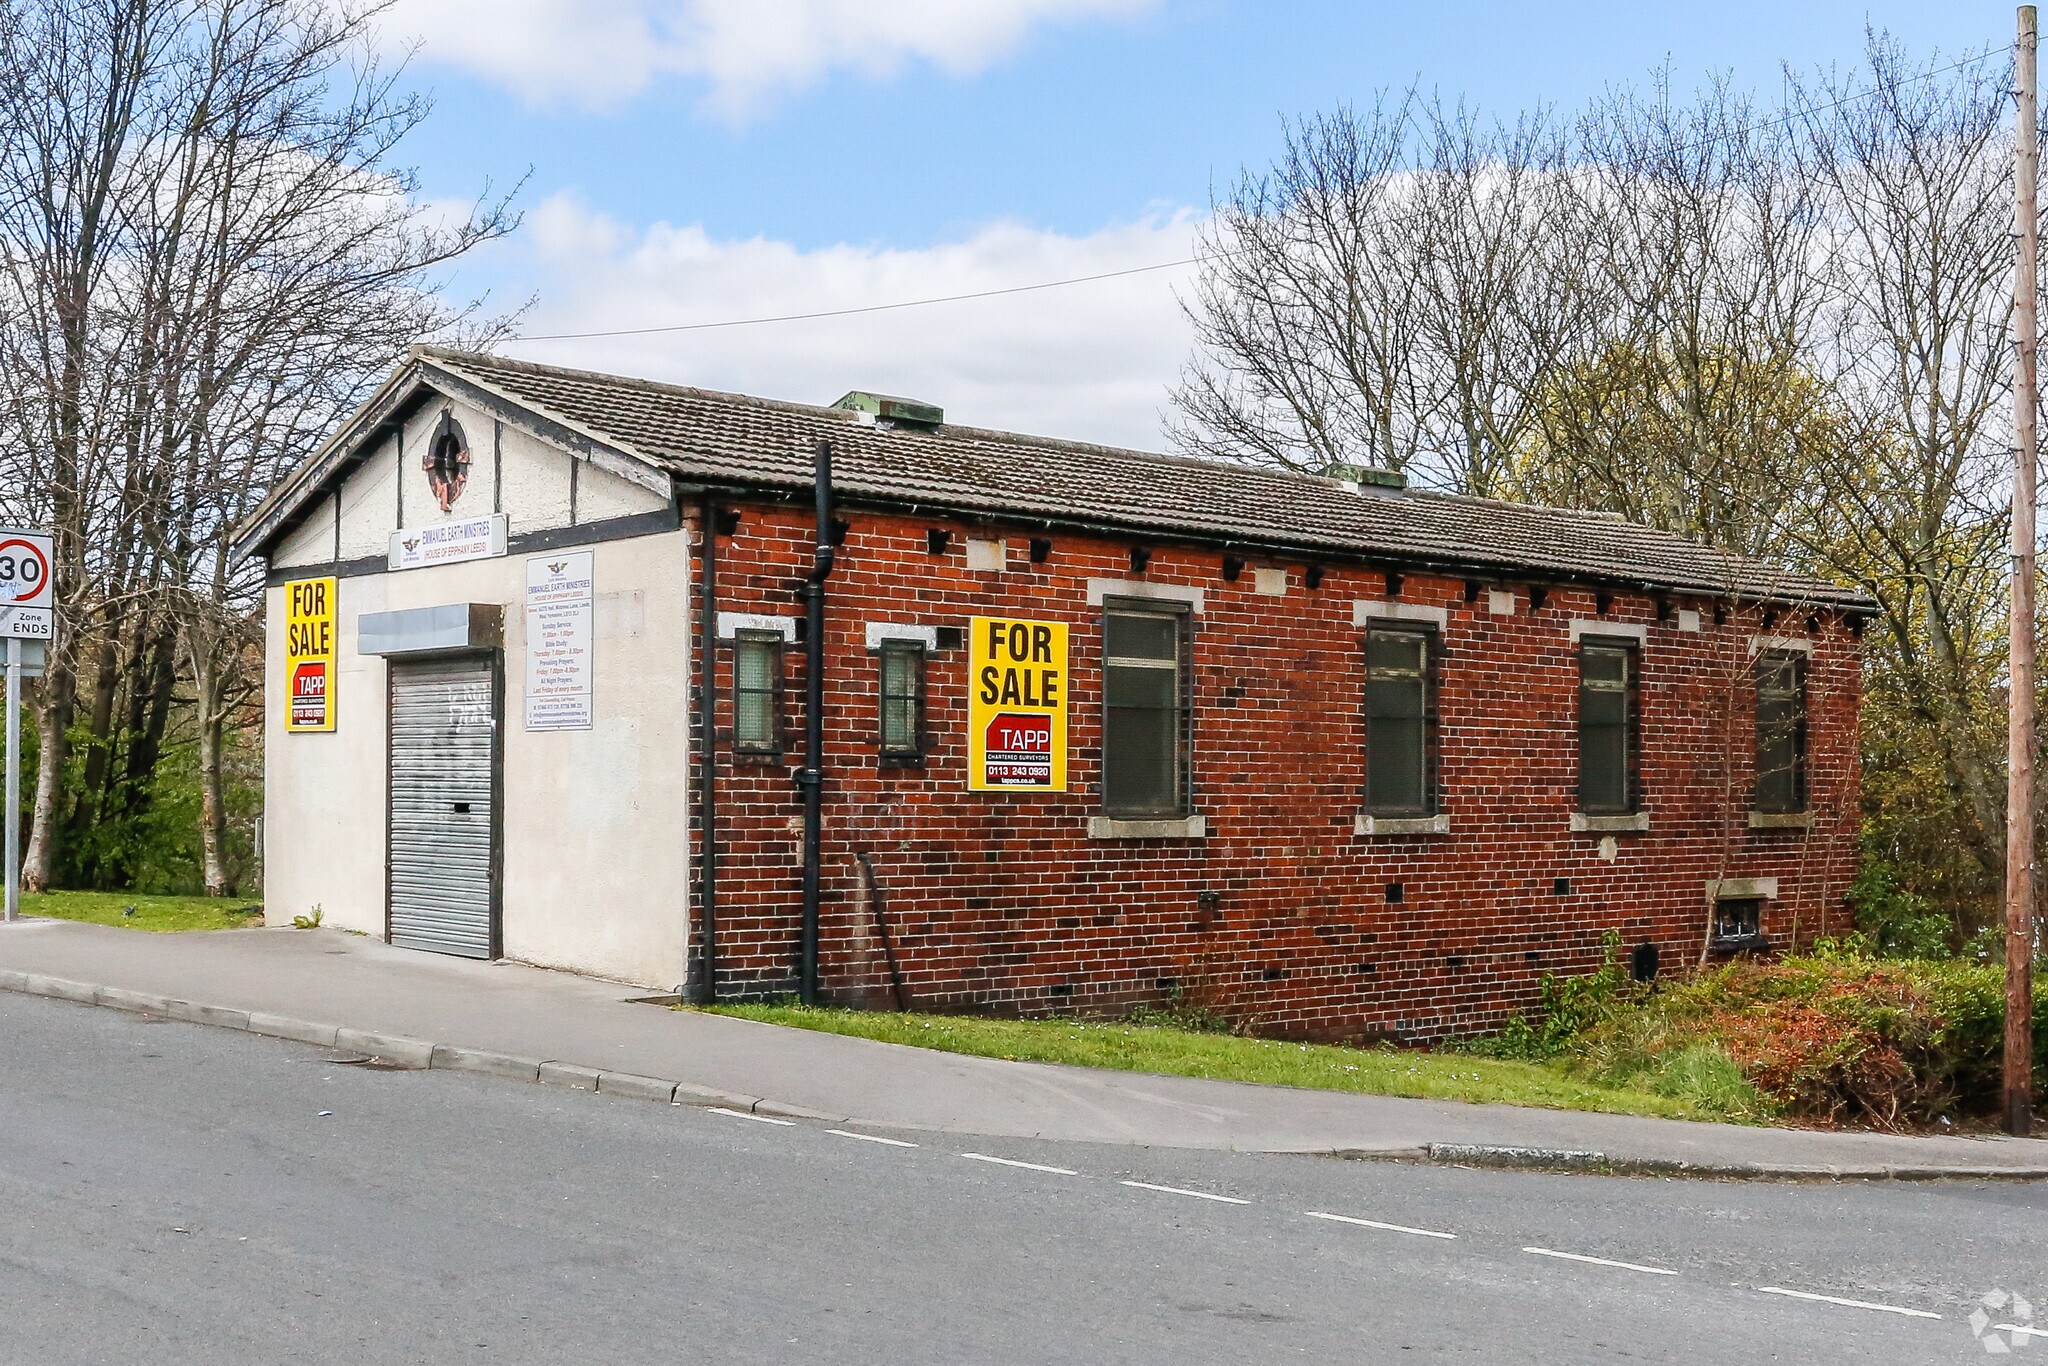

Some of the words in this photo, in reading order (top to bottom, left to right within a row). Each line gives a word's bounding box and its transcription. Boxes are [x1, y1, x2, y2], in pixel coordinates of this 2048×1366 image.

[422, 527, 447, 545] EMMANUEL
[448, 525, 463, 541] EARTH
[464, 520, 490, 539] MINISTRIES
[441, 546, 448, 558] OF
[448, 544, 470, 557] EPIPHANY
[0, 556, 39, 582] 30
[528, 584, 551, 594] EMMANUEL
[551, 581, 565, 592] EARTH
[566, 579, 590, 590] MINISTRIES
[292, 582, 326, 618] FOR
[20, 613, 42, 622] Zone
[13, 623, 48, 634] ENDS
[289, 621, 330, 657] SALE
[988, 621, 1052, 664] FOR
[299, 676, 325, 695] TAPP
[980, 665, 1059, 708] SALE
[1000, 729, 1049, 750] TAPP
[988, 766, 1008, 775] 0113
[1012, 767, 1027, 776] 243
[1028, 767, 1048, 776] 0920
